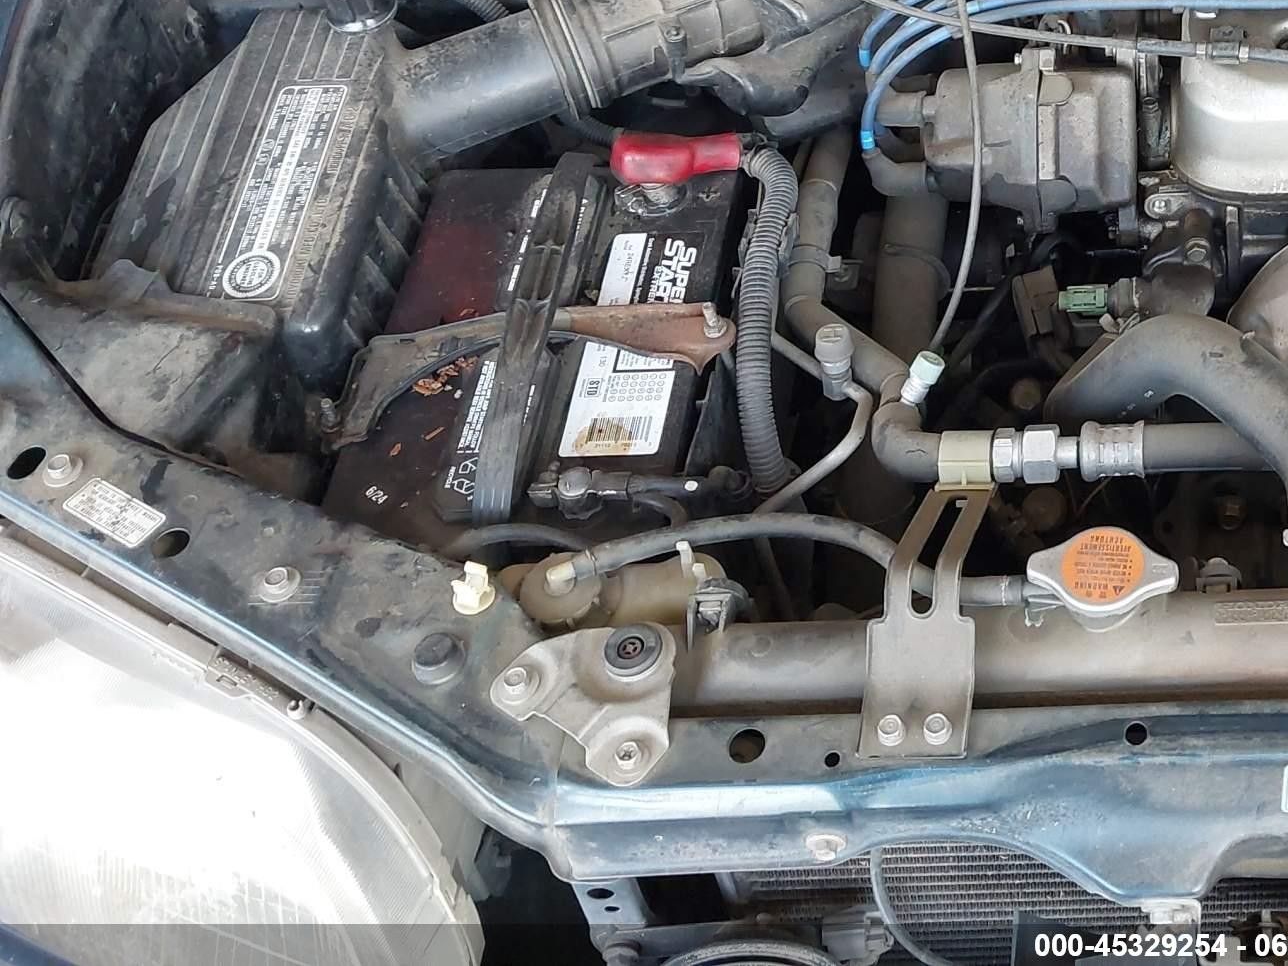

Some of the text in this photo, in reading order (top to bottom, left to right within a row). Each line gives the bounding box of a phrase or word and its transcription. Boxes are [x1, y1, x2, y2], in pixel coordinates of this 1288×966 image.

[646, 265, 663, 304] EXTRE
[586, 379, 600, 396] STD
[365, 485, 389, 505] 6/24
[1074, 581, 1108, 590] WARNING
